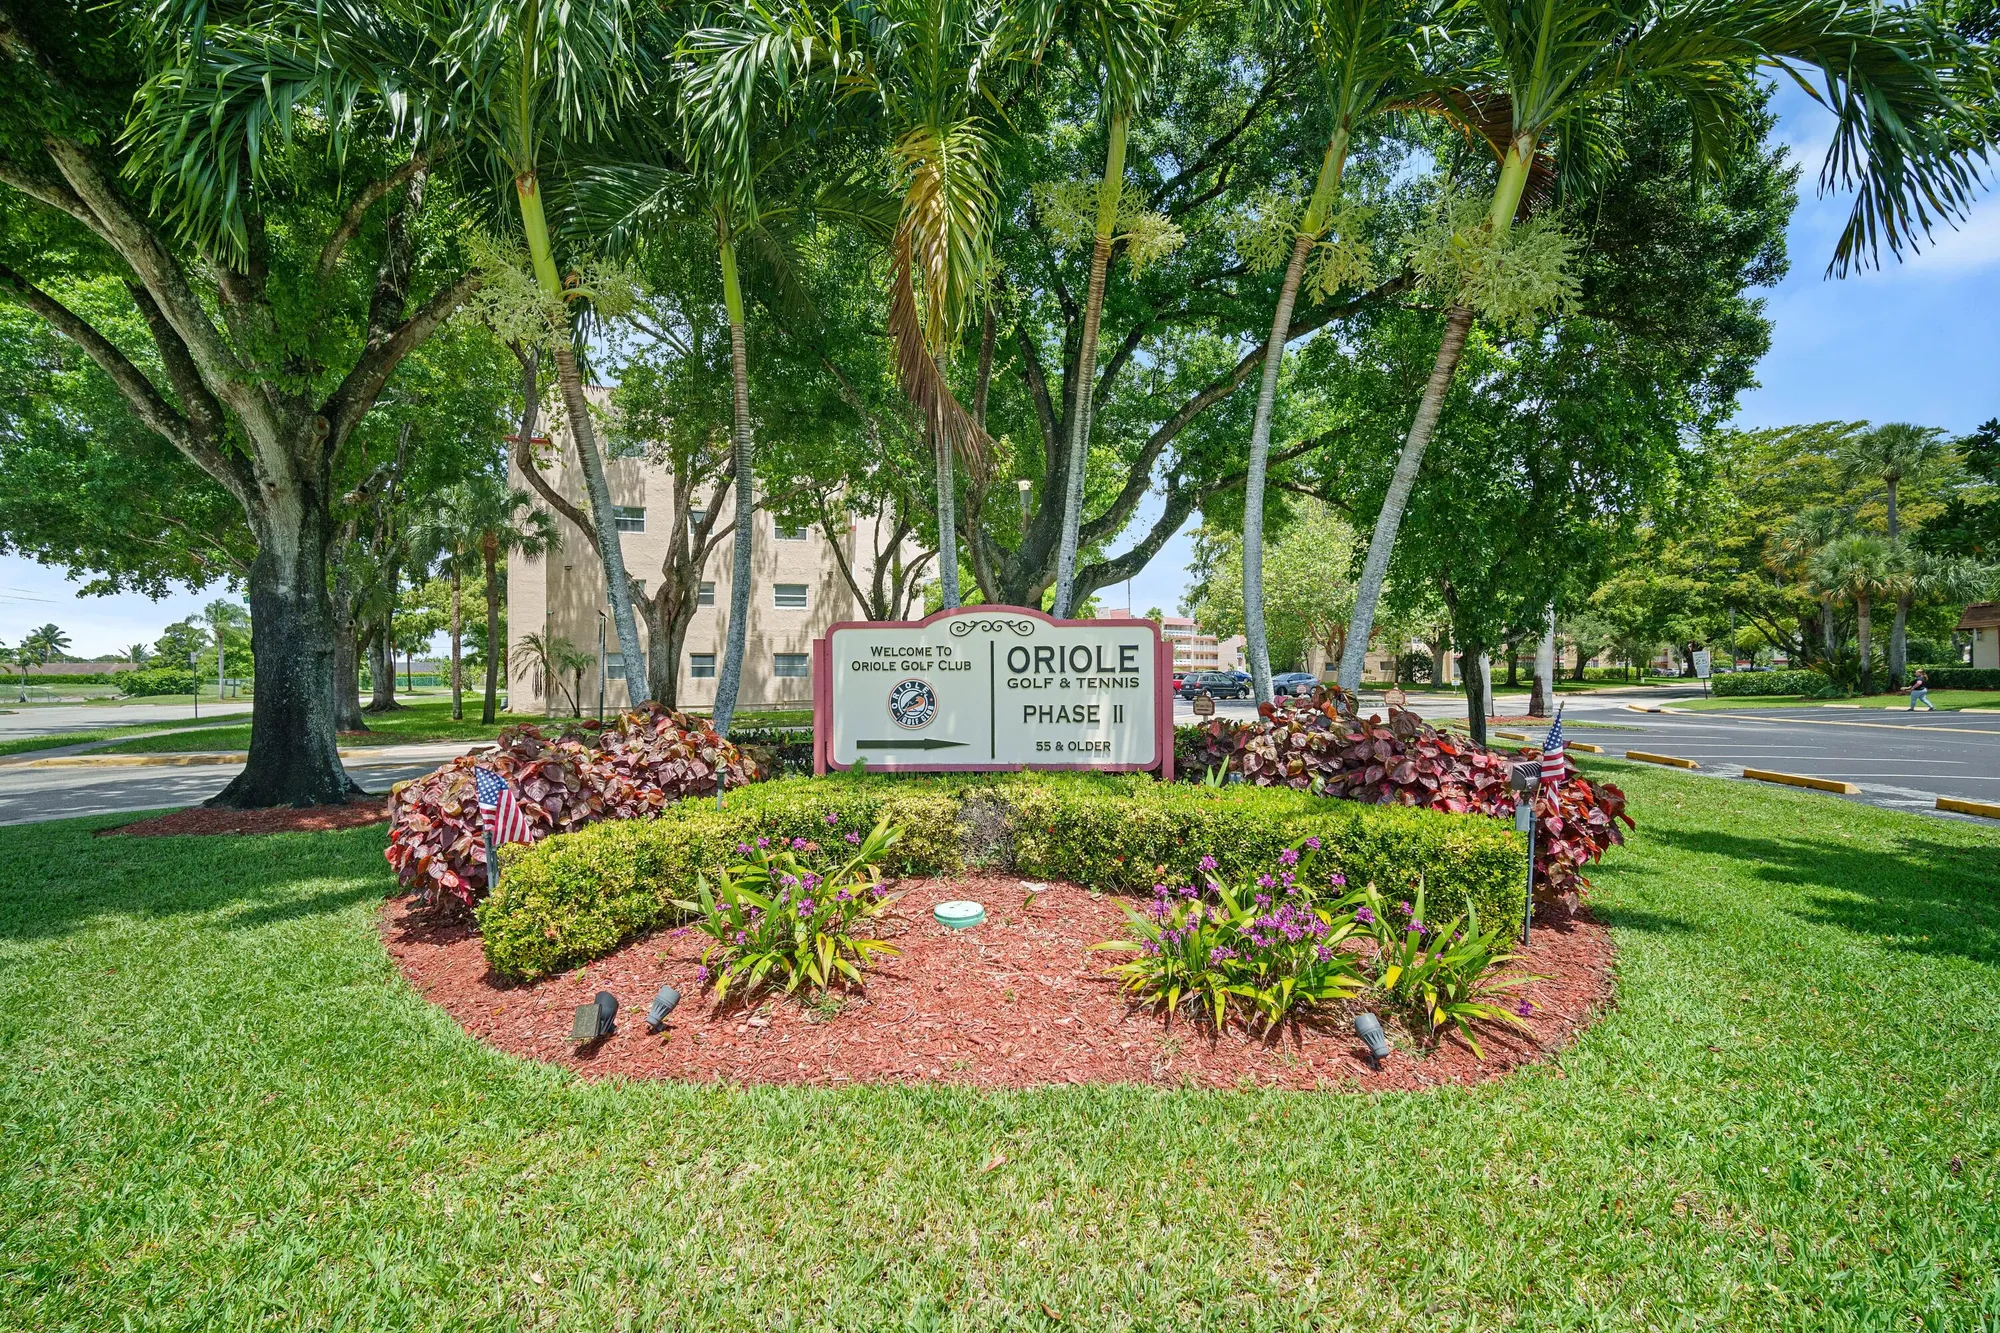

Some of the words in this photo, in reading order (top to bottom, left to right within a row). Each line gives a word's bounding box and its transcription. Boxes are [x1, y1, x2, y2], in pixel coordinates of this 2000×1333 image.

[870, 646, 933, 657] WELCOME
[1007, 645, 1140, 674] ORIOLE
[851, 660, 897, 672] ORIOLE
[901, 660, 934, 671] GOLF
[938, 660, 972, 671] CLUB
[1007, 677, 1054, 689] GOLF
[1059, 677, 1071, 689] &
[1076, 677, 1140, 689] TENNIS
[891, 682, 930, 709] ORIOLE
[1023, 704, 1101, 724] PHASE
[1113, 704, 1123, 724] II
[902, 717, 919, 725] GOLF
[1036, 741, 1051, 752] 55
[1055, 741, 1064, 752] &
[1068, 741, 1111, 752] OLDER
